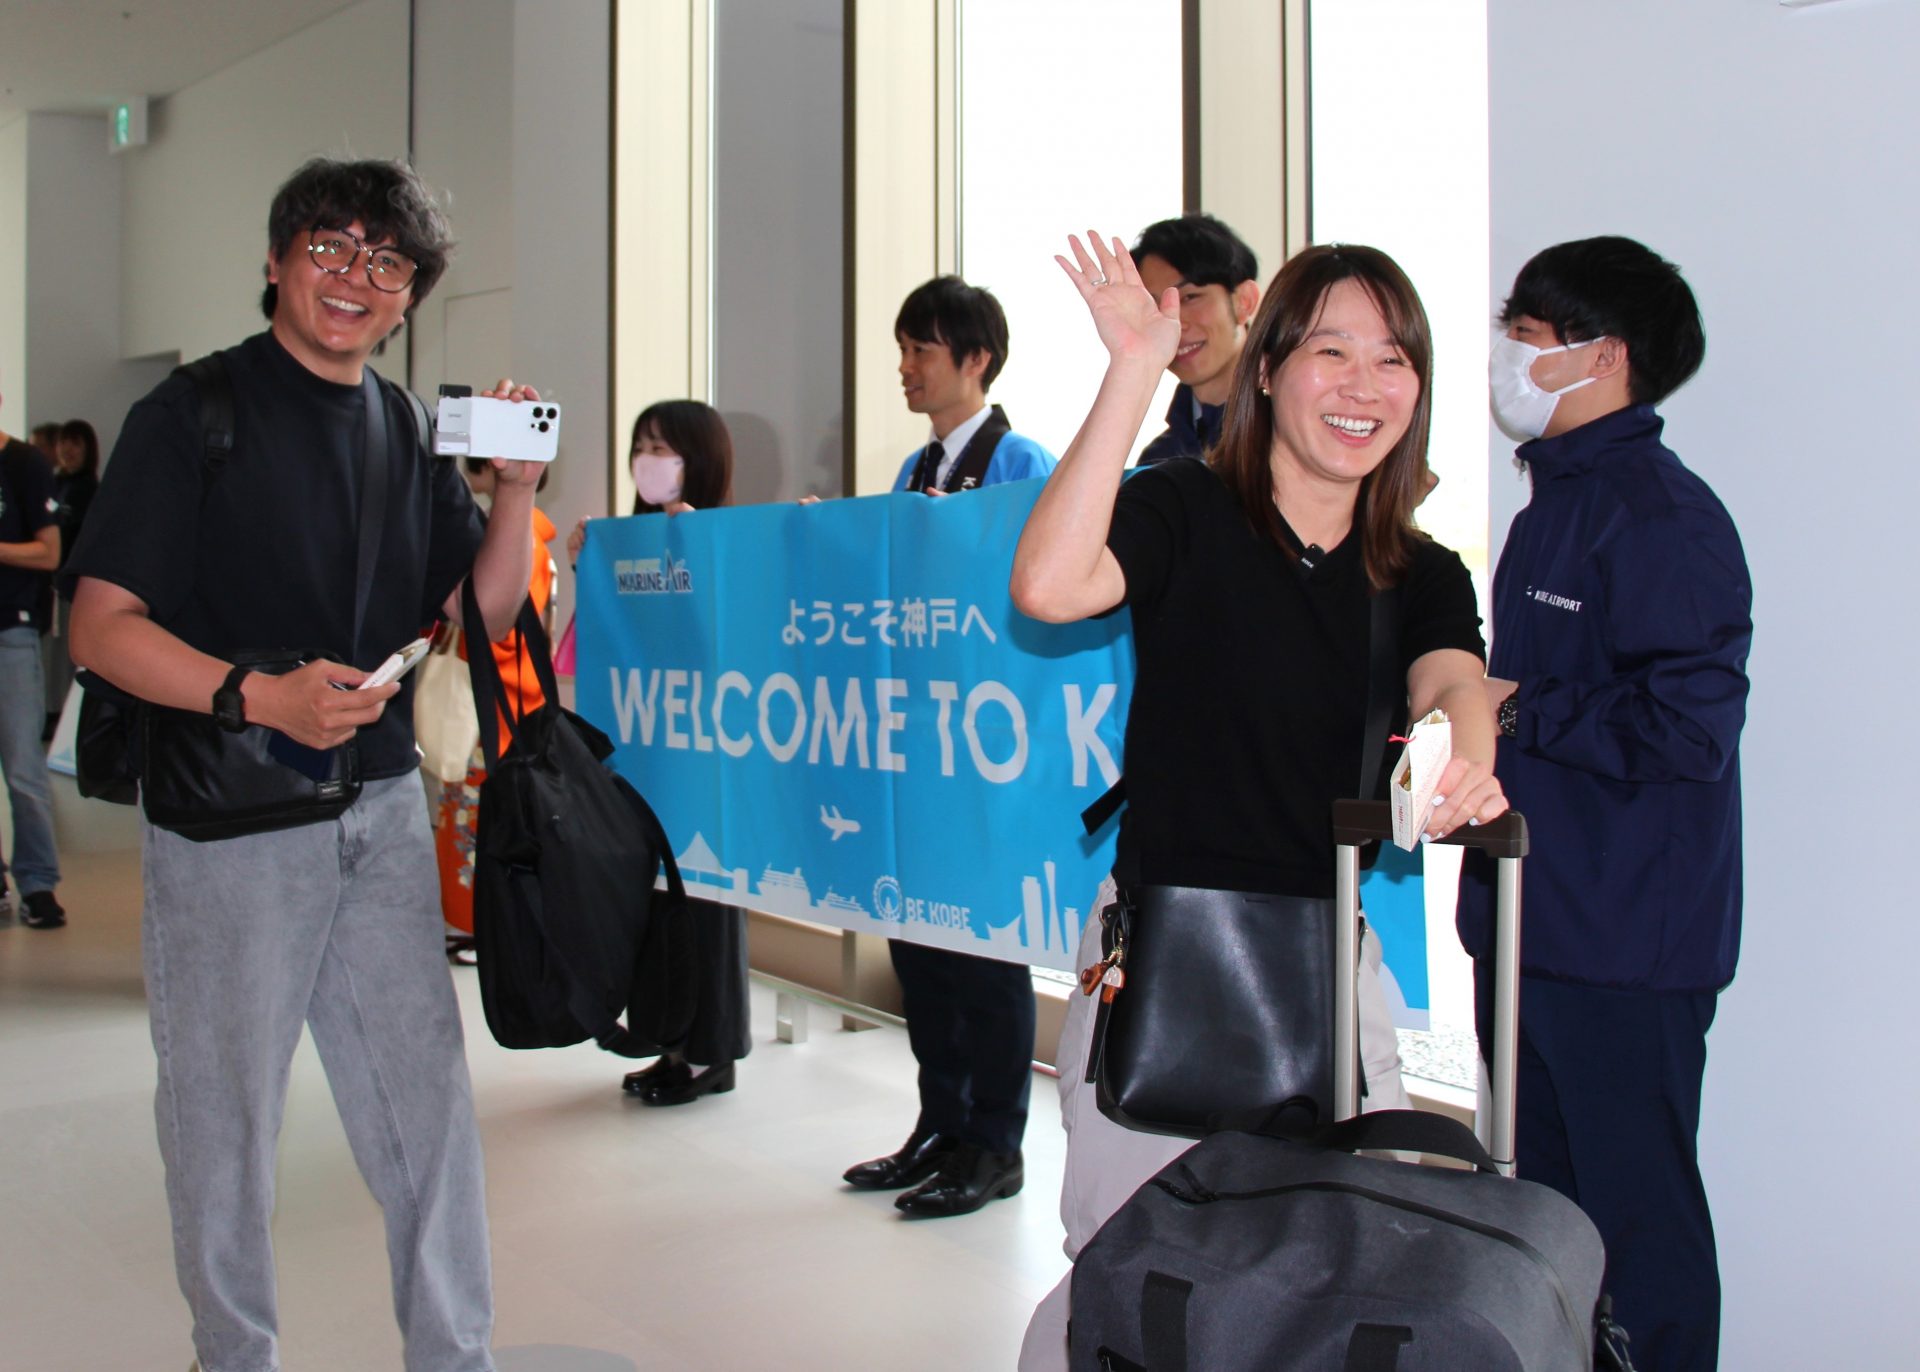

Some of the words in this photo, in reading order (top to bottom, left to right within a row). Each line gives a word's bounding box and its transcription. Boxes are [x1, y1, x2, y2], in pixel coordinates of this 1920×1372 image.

[617, 570, 662, 593] MARINE
[664, 549, 692, 593] AIR
[781, 597, 998, 649] ようこそ神戸へ
[1547, 594, 1582, 612] AIRPORT
[609, 666, 909, 773] WELCOME
[928, 679, 1029, 784] TO
[905, 897, 926, 922] BE
[928, 901, 971, 930] KOBE
